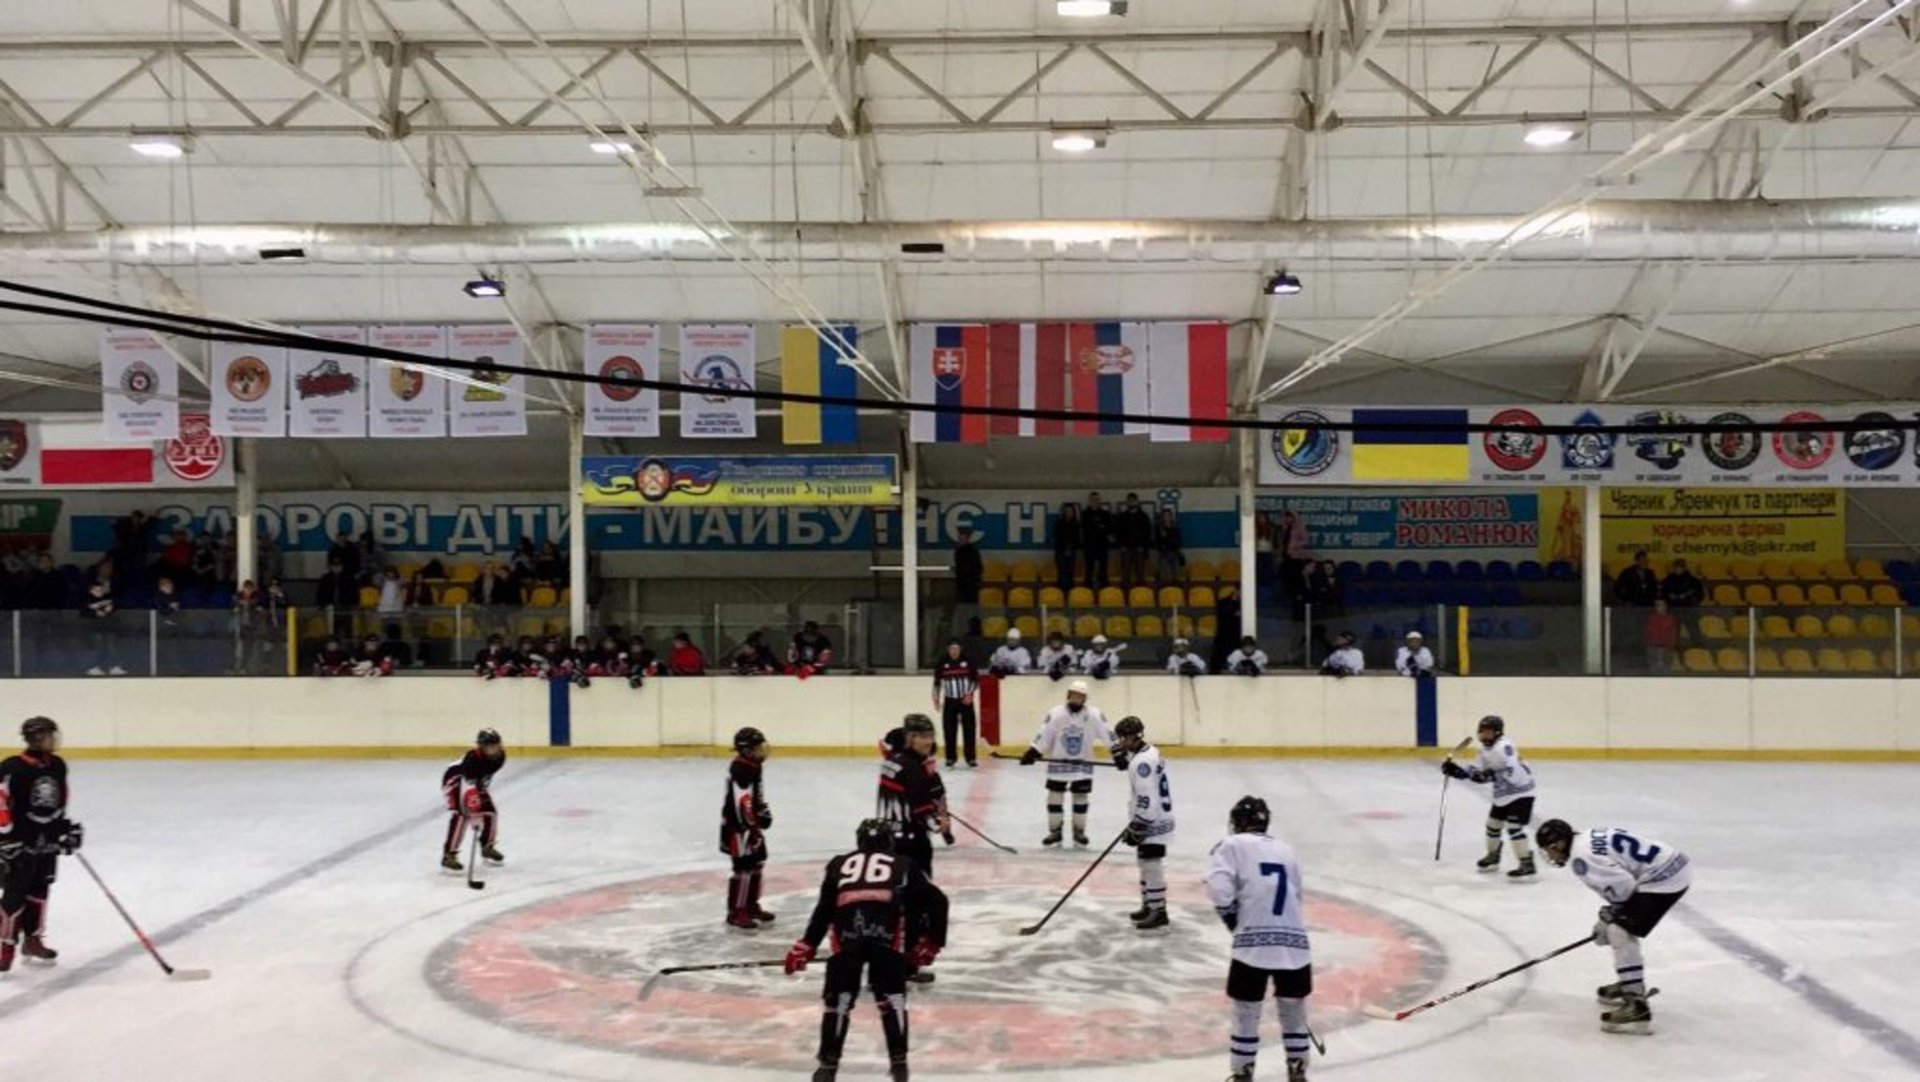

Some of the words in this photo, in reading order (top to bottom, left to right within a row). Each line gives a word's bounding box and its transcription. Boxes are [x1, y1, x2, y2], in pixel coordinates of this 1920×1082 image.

[1397, 496, 1511, 521] МИКОЛА
[1396, 522, 1538, 548] РОМАНЮК
[1611, 829, 1661, 864] 2
[837, 852, 896, 888] 96
[1260, 862, 1288, 916] 7
